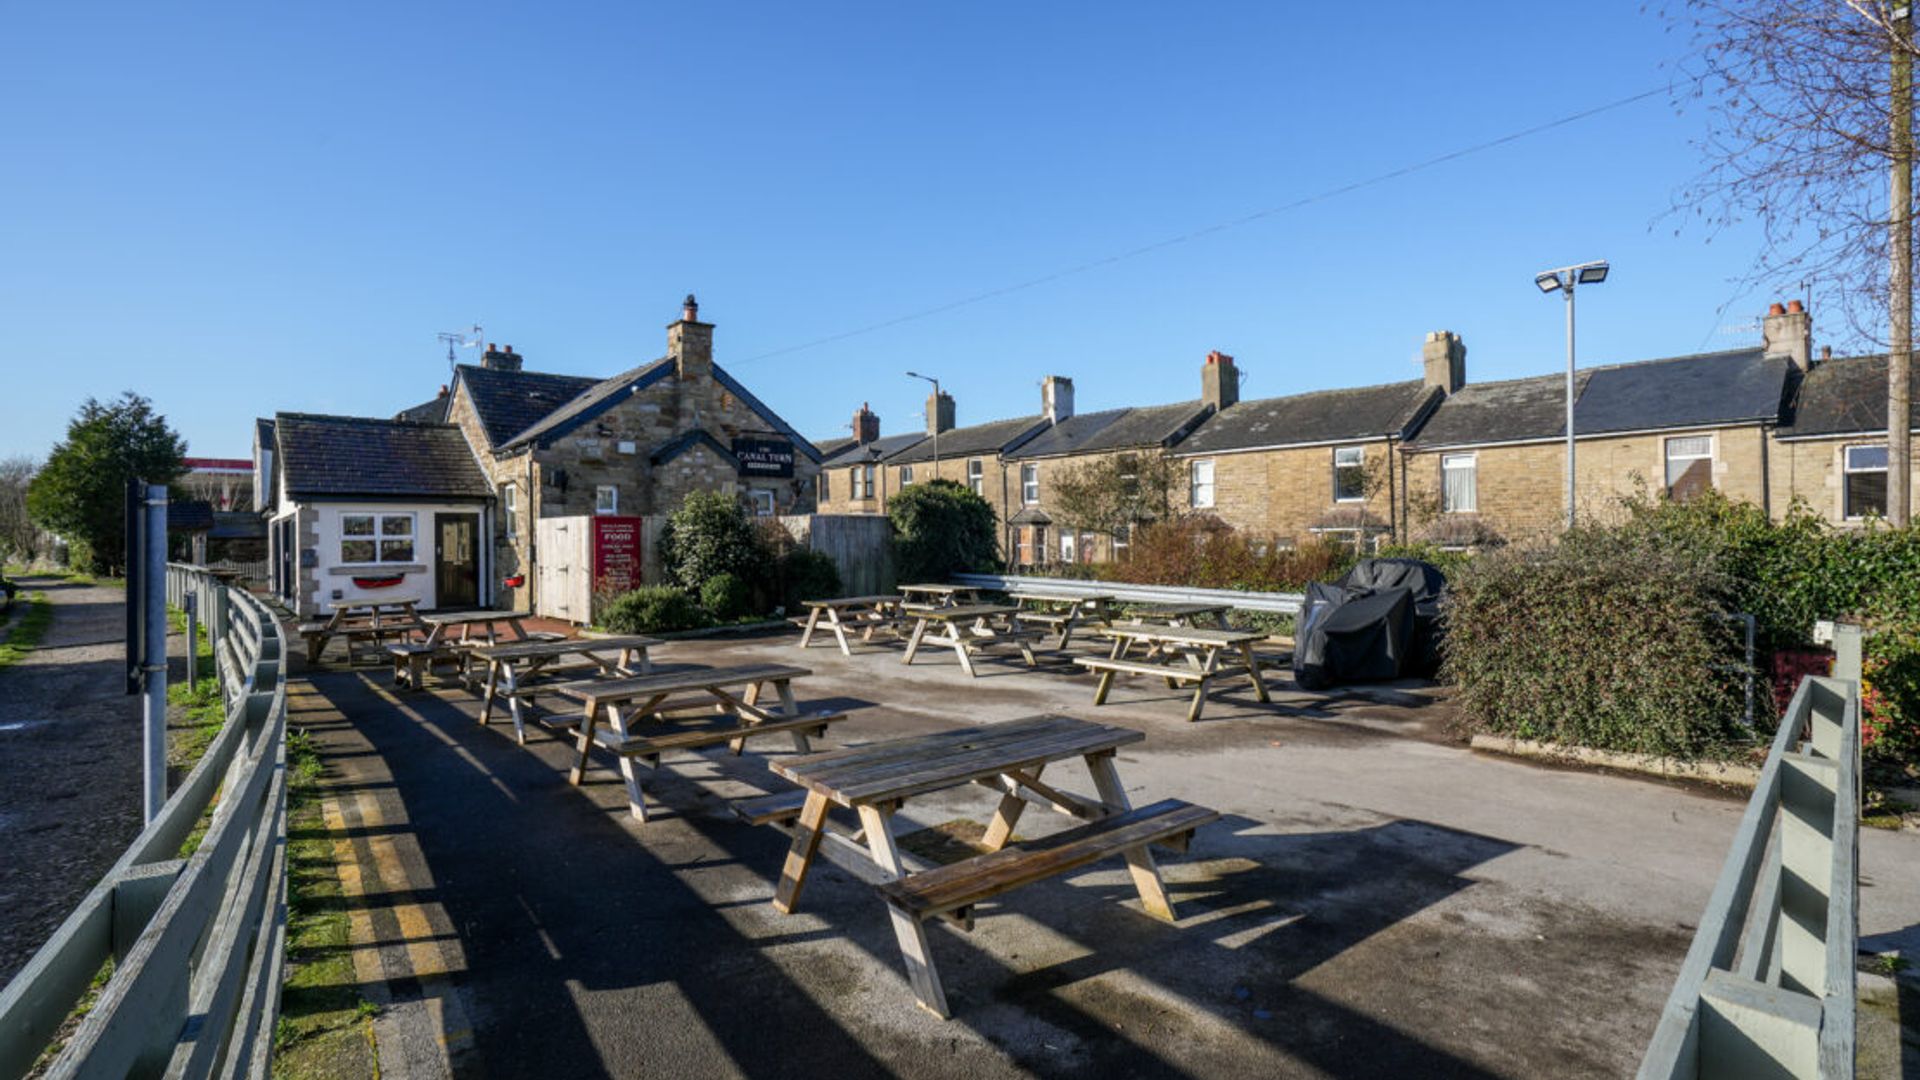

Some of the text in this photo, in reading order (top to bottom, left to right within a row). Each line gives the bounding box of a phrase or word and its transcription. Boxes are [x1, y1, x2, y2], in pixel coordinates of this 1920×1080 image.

[737, 451, 792, 464] CANAL TURN
[604, 533, 632, 541] FOOD
